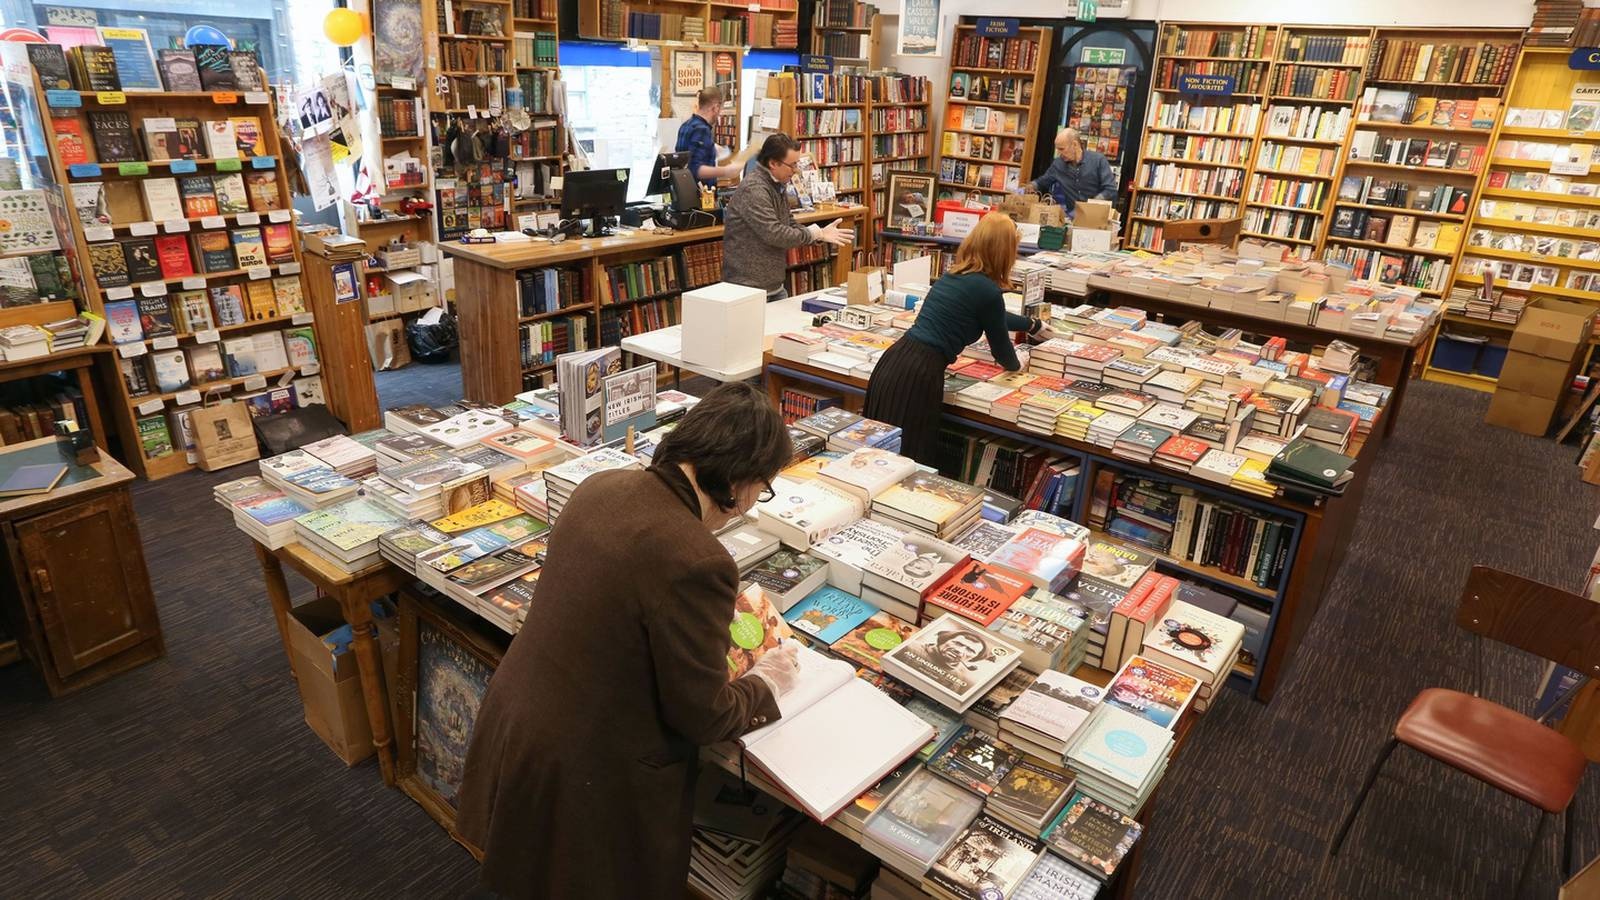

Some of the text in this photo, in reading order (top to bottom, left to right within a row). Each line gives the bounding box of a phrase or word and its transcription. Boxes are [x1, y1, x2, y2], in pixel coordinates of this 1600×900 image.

[678, 69, 702, 78] BOOK
[678, 78, 702, 87] SHOP
[1187, 83, 1224, 91] FAVOURITES
[95, 120, 130, 129] FACES
[140, 297, 164, 306] NIGHT
[141, 303, 168, 311] TRAINS
[608, 395, 642, 410] NEW IRISH
[608, 406, 631, 418] TITLES
[945, 583, 1000, 608] HISTORY IS
[938, 590, 994, 617] FUTURE THE
[1028, 616, 1062, 636] WILL
[905, 650, 916, 658] AN
[916, 656, 946, 675] UNSUNG
[946, 673, 968, 687] HERO
[988, 825, 1034, 850] IRELAND
[1031, 872, 1085, 900] MAMMY
[1046, 867, 1082, 891] IRISH
